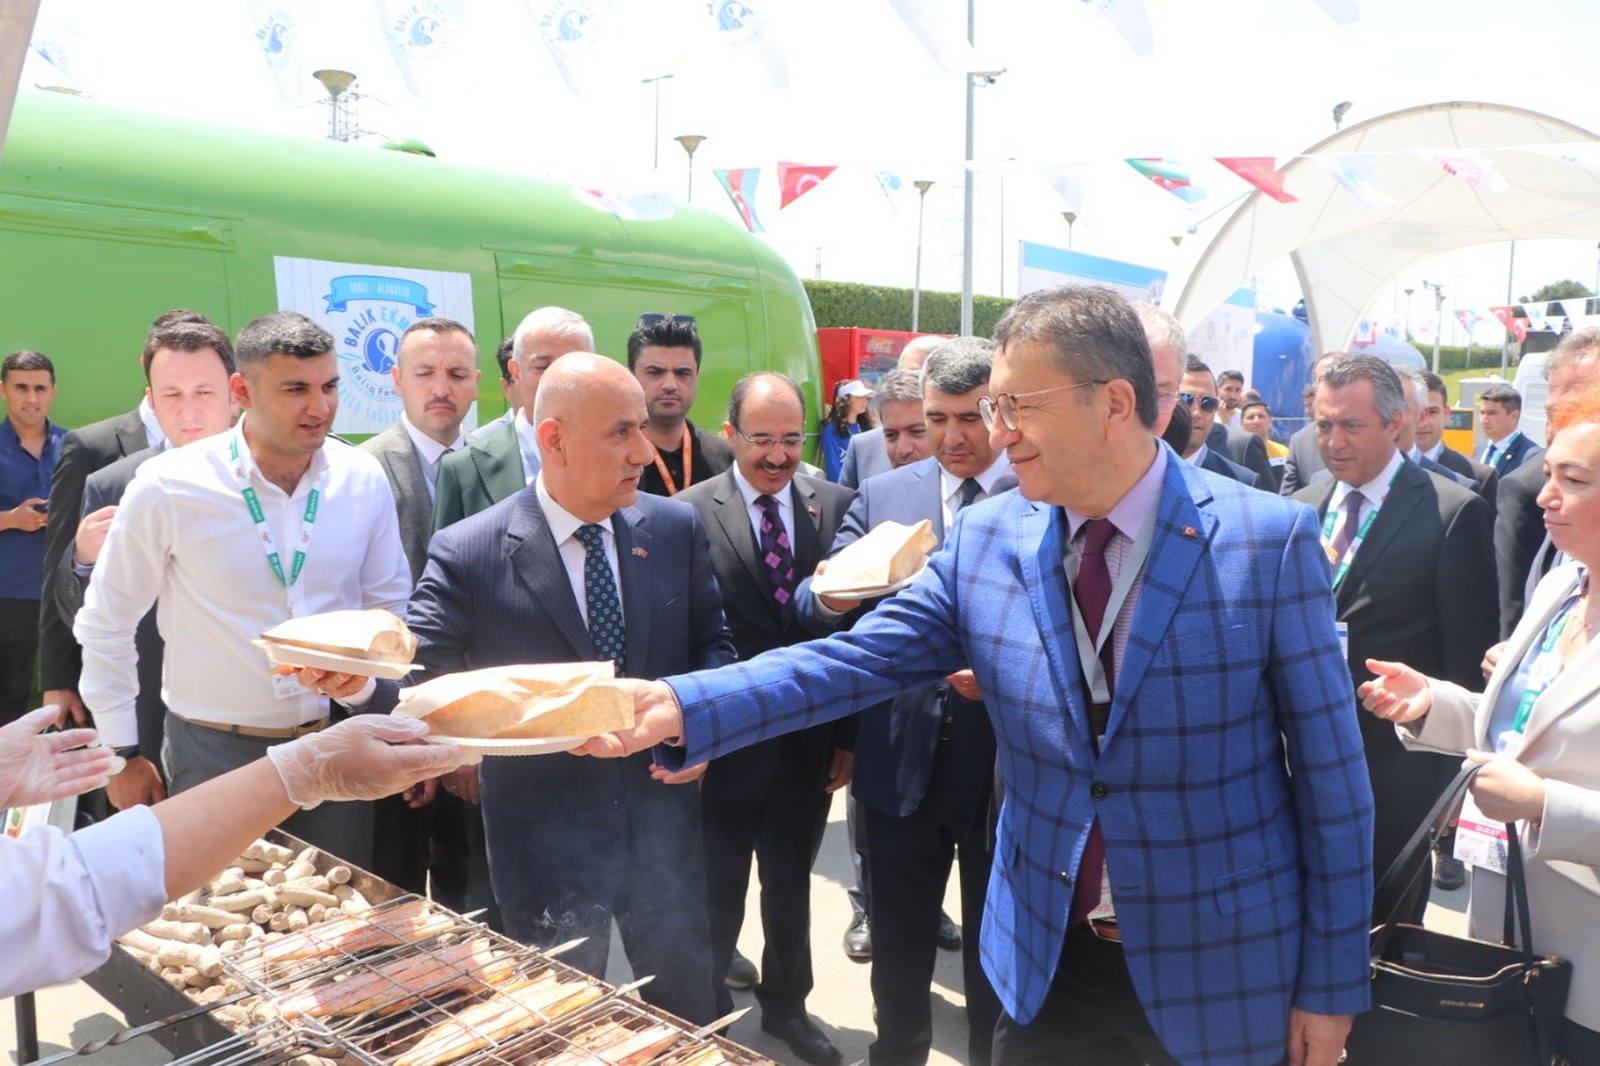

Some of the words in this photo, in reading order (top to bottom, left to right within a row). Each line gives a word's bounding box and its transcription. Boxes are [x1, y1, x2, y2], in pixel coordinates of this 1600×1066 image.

[344, 308, 377, 347] BALIK
[381, 306, 411, 332] EKM
[378, 387, 396, 397] Fes
[1474, 823, 1501, 837] GUEST
